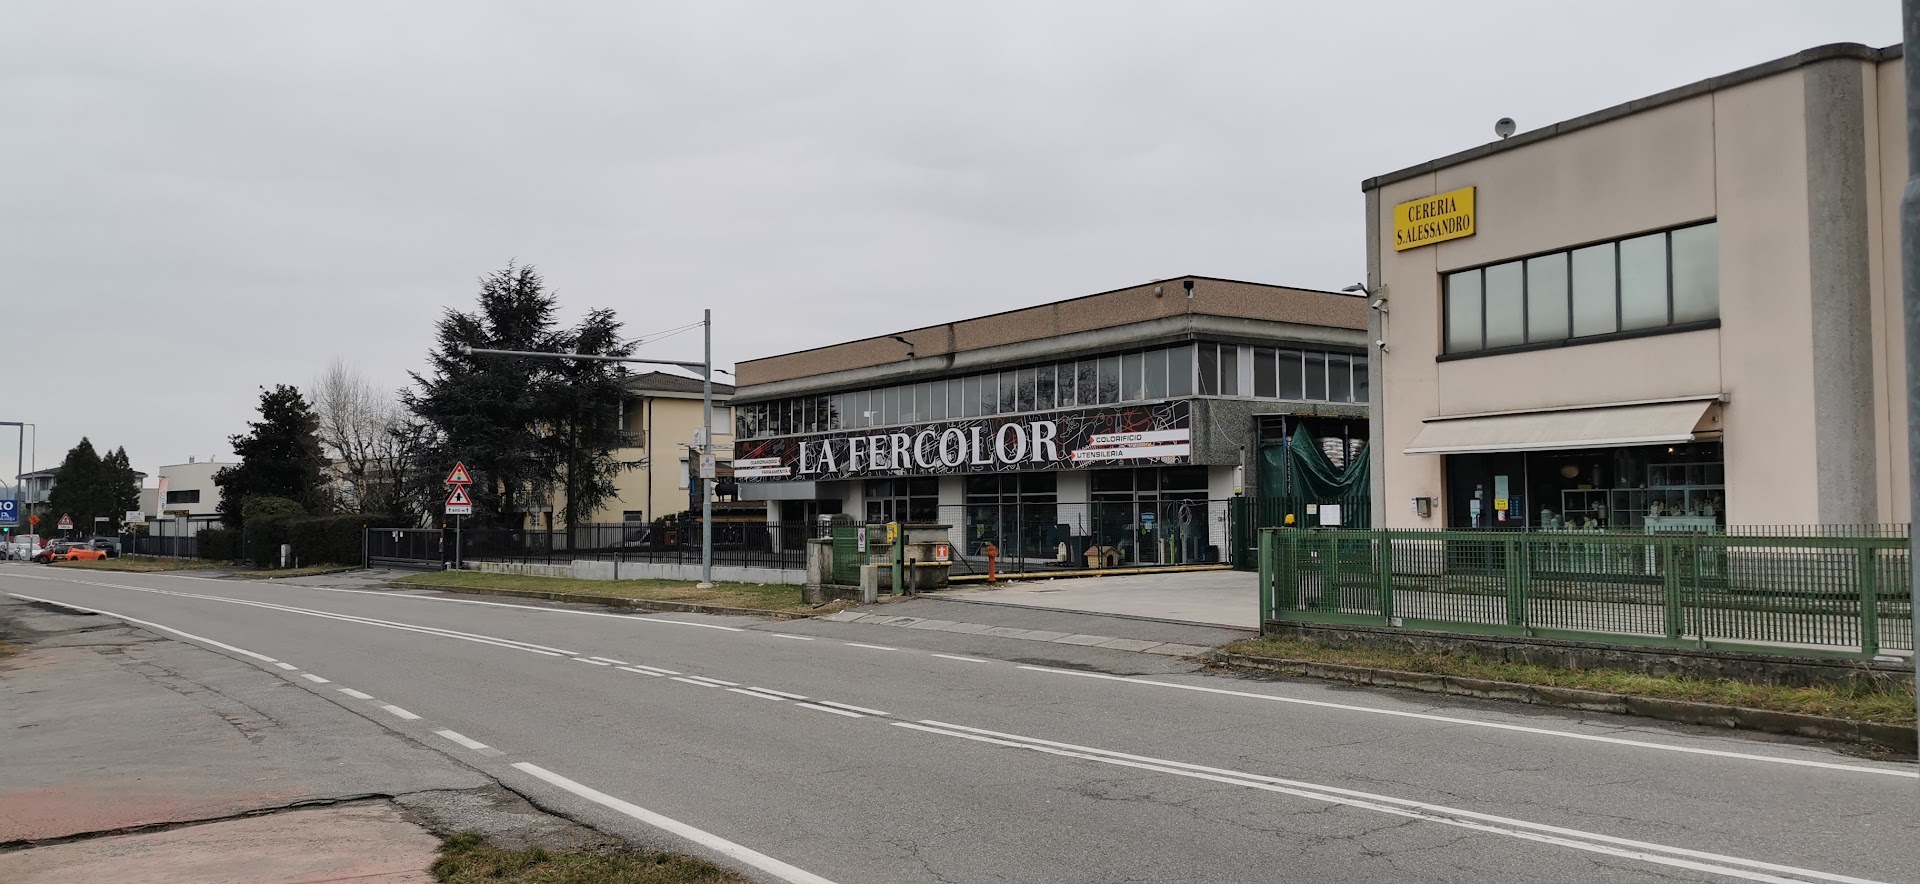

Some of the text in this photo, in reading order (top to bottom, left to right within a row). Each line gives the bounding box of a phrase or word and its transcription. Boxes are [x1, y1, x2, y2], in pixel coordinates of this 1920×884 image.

[1408, 196, 1456, 222] CERERIA
[1397, 213, 1470, 245] S.ALESSANDRO
[797, 420, 1061, 474] LA FERCOLOR
[1095, 434, 1142, 443] COLORIFICIO
[1076, 450, 1124, 459] UTENSILERIA
